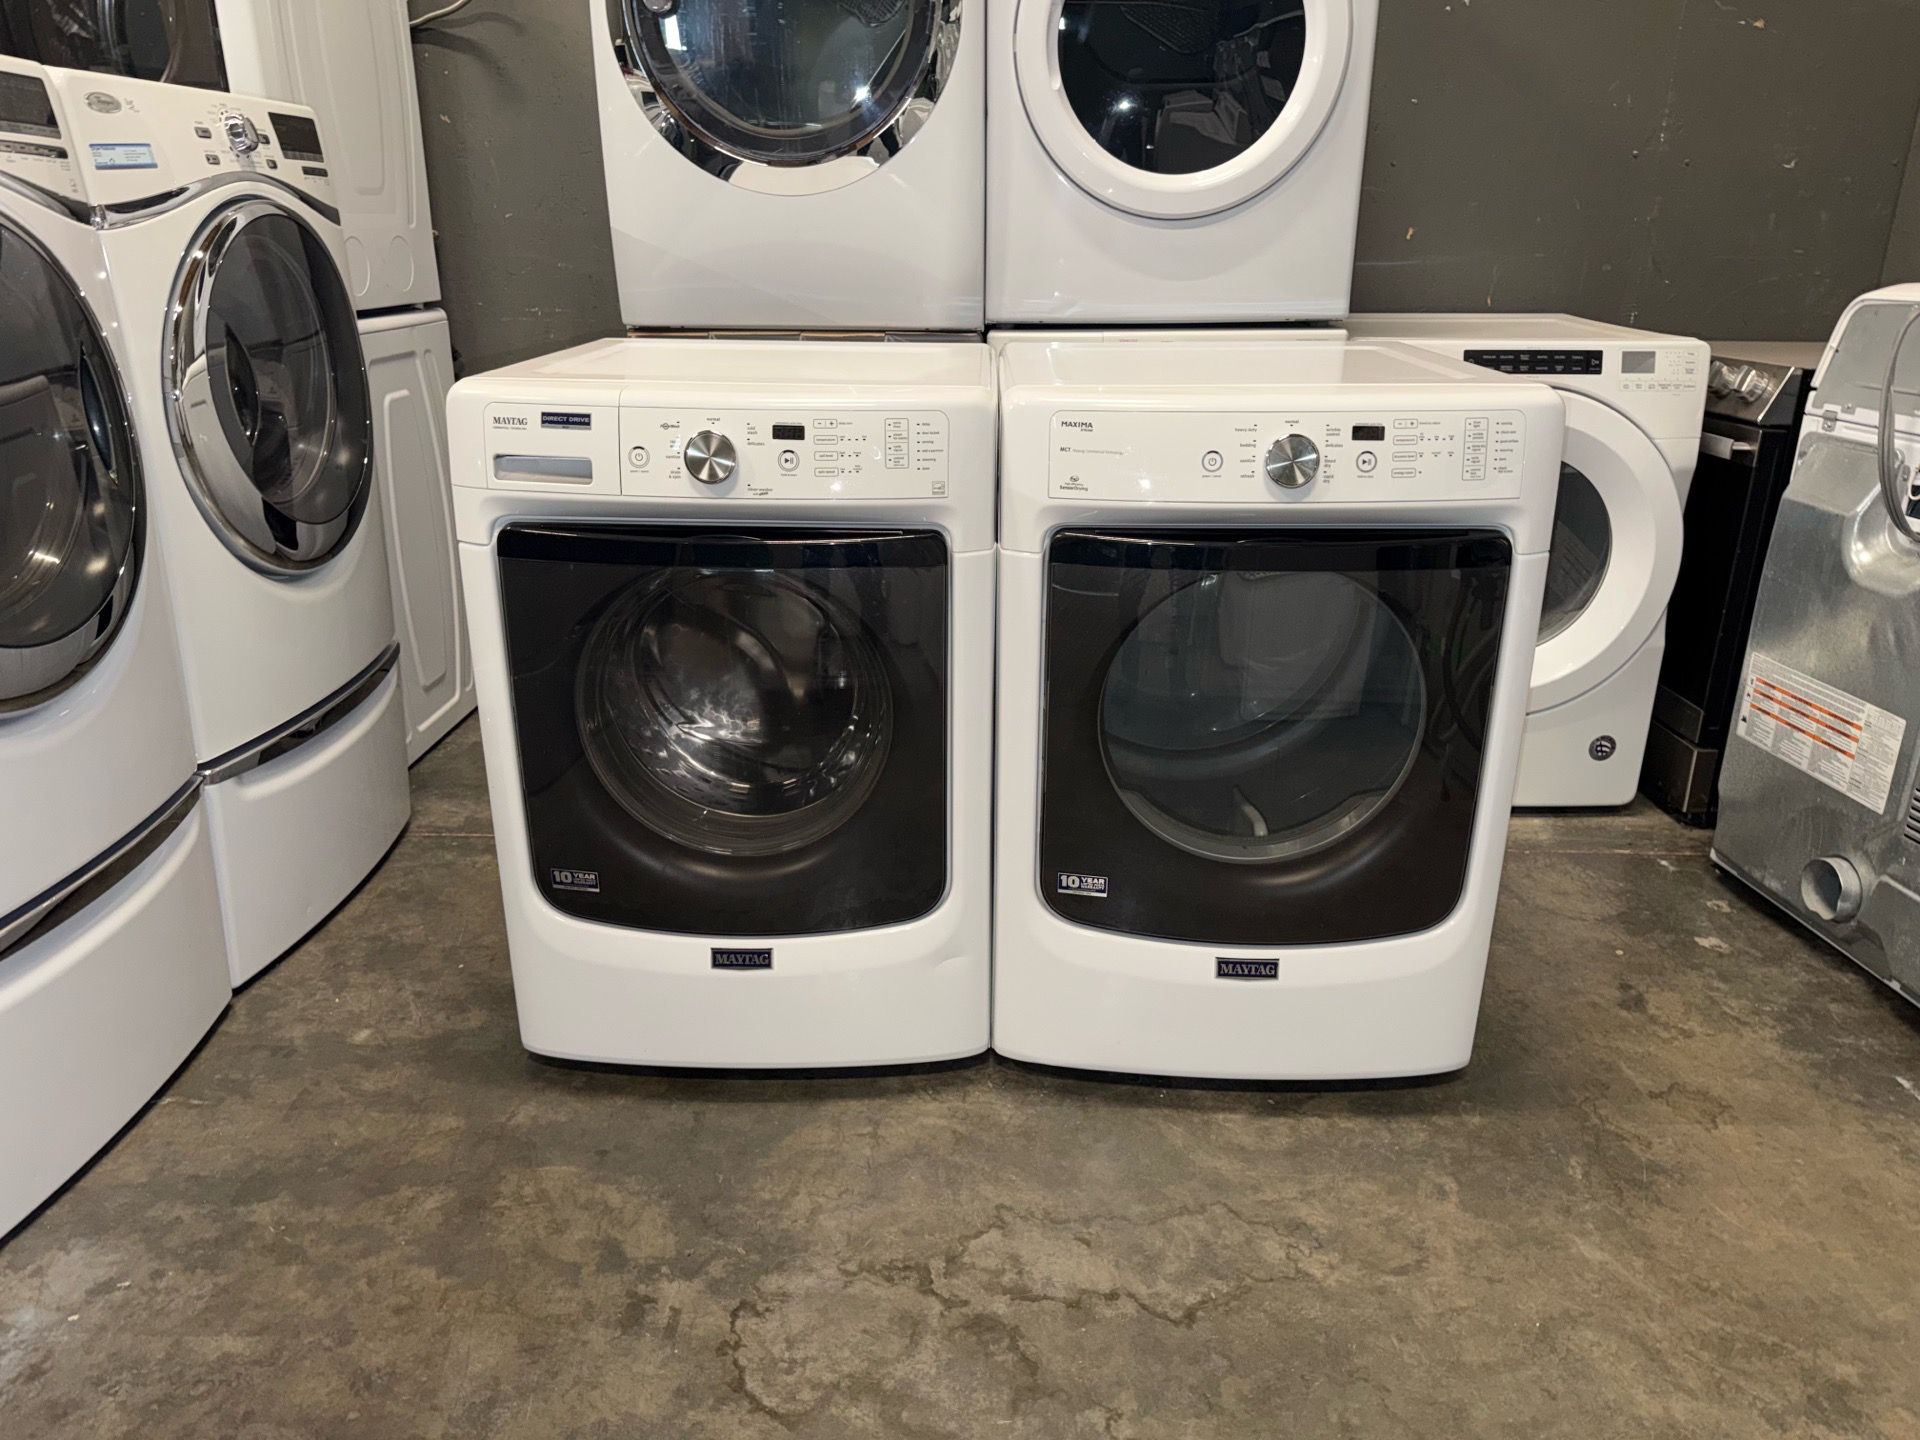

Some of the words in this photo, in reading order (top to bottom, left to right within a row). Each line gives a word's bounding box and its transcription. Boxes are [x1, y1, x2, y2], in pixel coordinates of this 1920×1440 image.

[492, 416, 528, 426] MAYTAG
[1061, 421, 1094, 429] MAXIMA
[553, 871, 573, 884] 10
[573, 872, 596, 880] YEAR
[1060, 875, 1080, 888] 10
[714, 953, 769, 966] MAYTAG
[1219, 962, 1277, 976] MAYTAG
